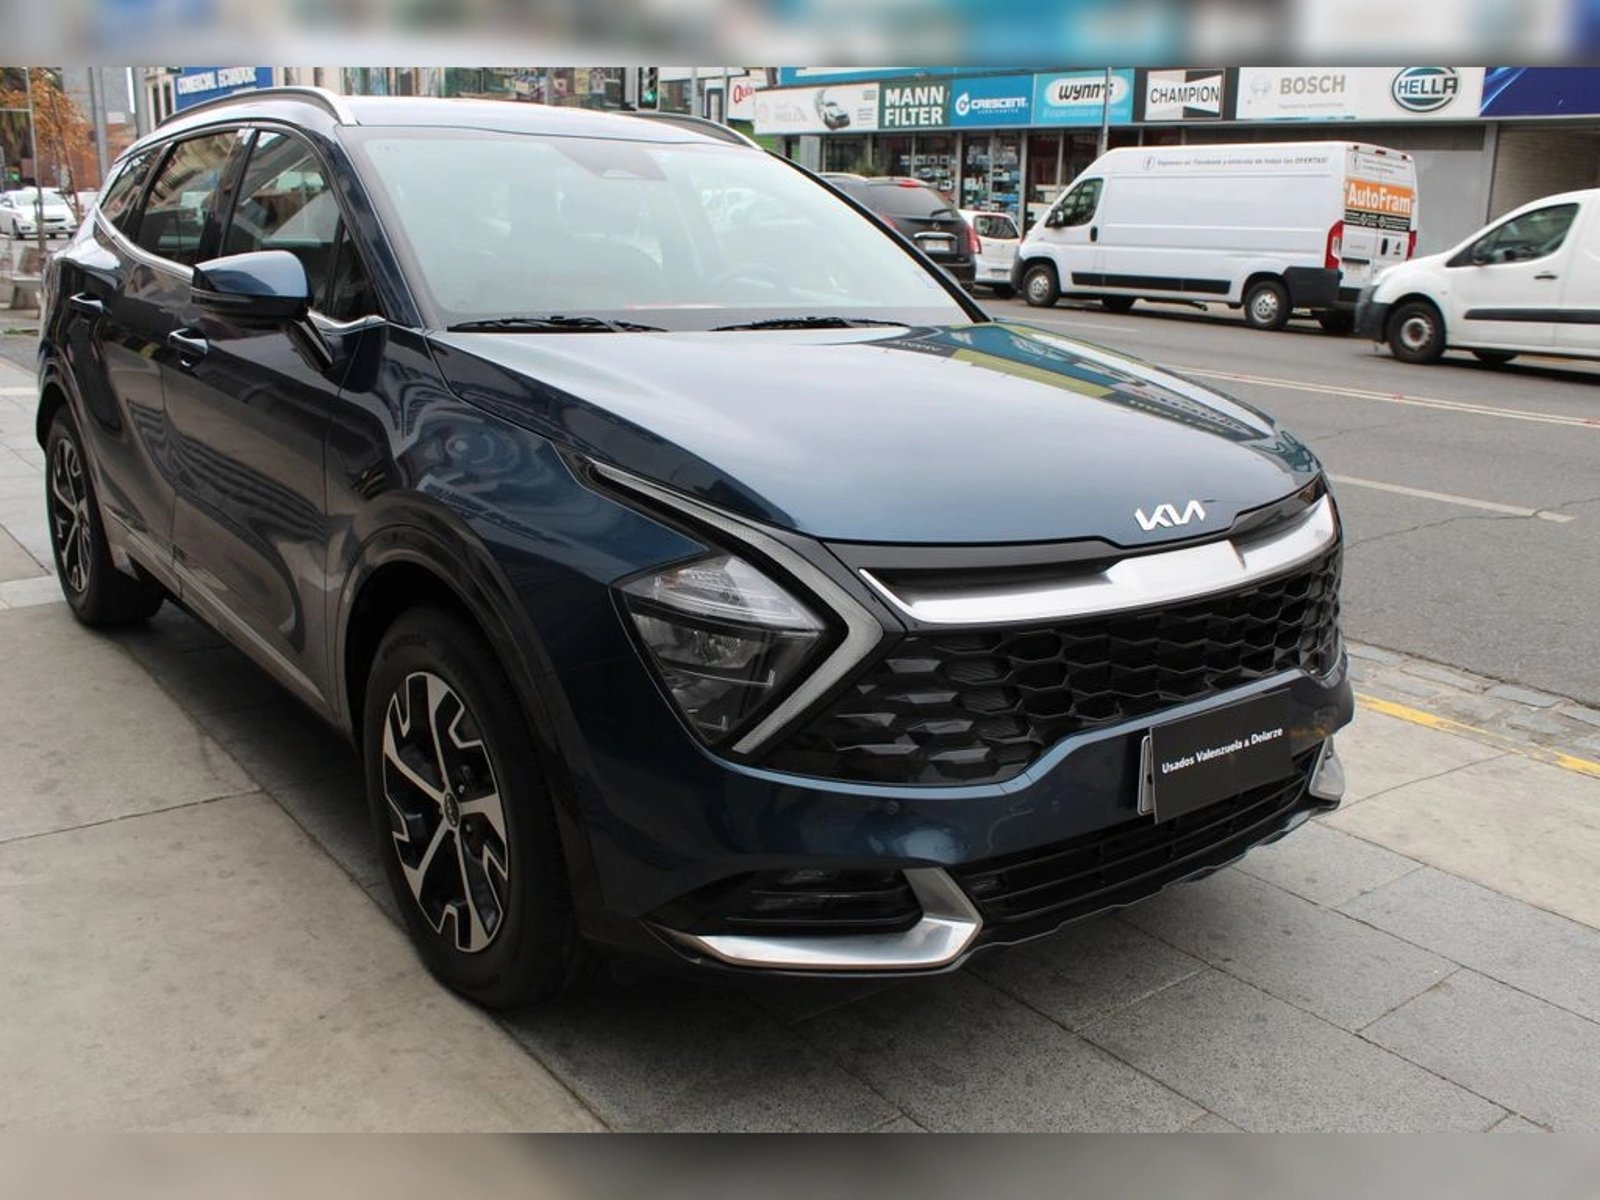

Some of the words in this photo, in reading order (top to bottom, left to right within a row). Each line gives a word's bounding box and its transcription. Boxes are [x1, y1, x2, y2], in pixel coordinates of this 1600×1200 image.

[1150, 86, 1220, 104] CHAMPION
[1280, 74, 1346, 95] BOSCH
[1397, 77, 1459, 95] HELLA
[884, 85, 945, 107] MANN
[884, 107, 944, 127] FILTER
[1347, 182, 1411, 214] AutoFram
[1134, 499, 1207, 532] KIA
[1161, 756, 1195, 774] Usados
[1196, 739, 1243, 763] Valenzuela
[1251, 727, 1284, 745] Delarze
